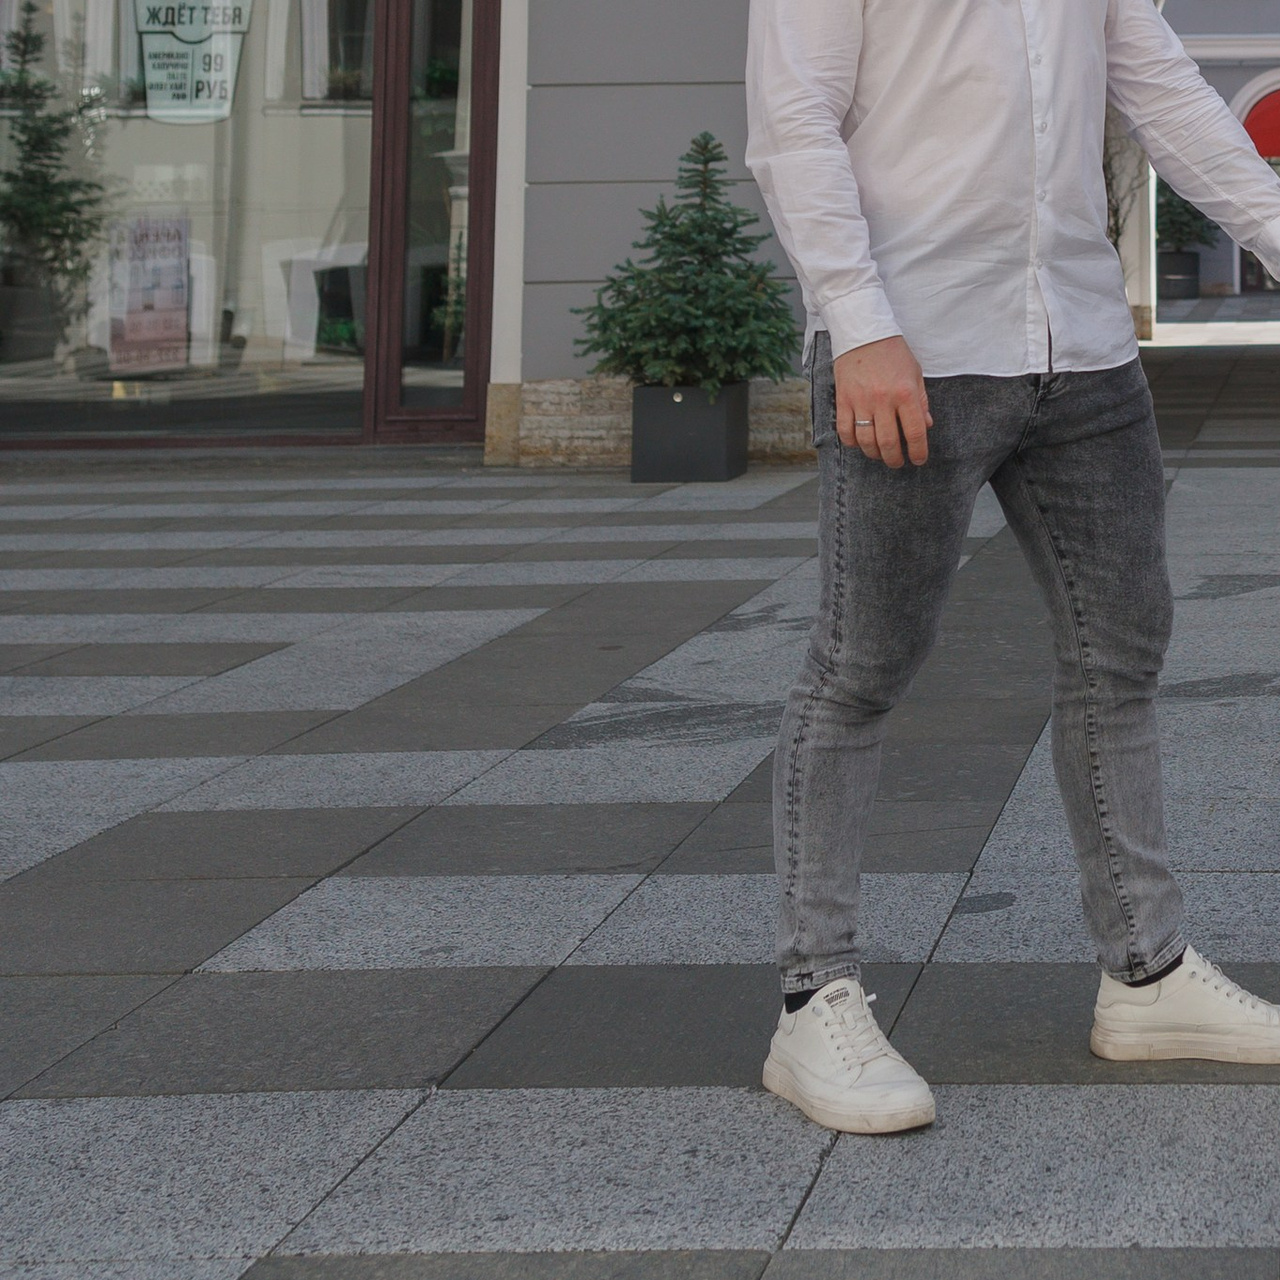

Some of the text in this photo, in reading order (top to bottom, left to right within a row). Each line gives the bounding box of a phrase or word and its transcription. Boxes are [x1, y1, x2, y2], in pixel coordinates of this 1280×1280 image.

[146, 2, 242, 26] ЖДЁТ ТЕБЯ
[202, 53, 223, 73] 99
[195, 79, 228, 100] РУБ
